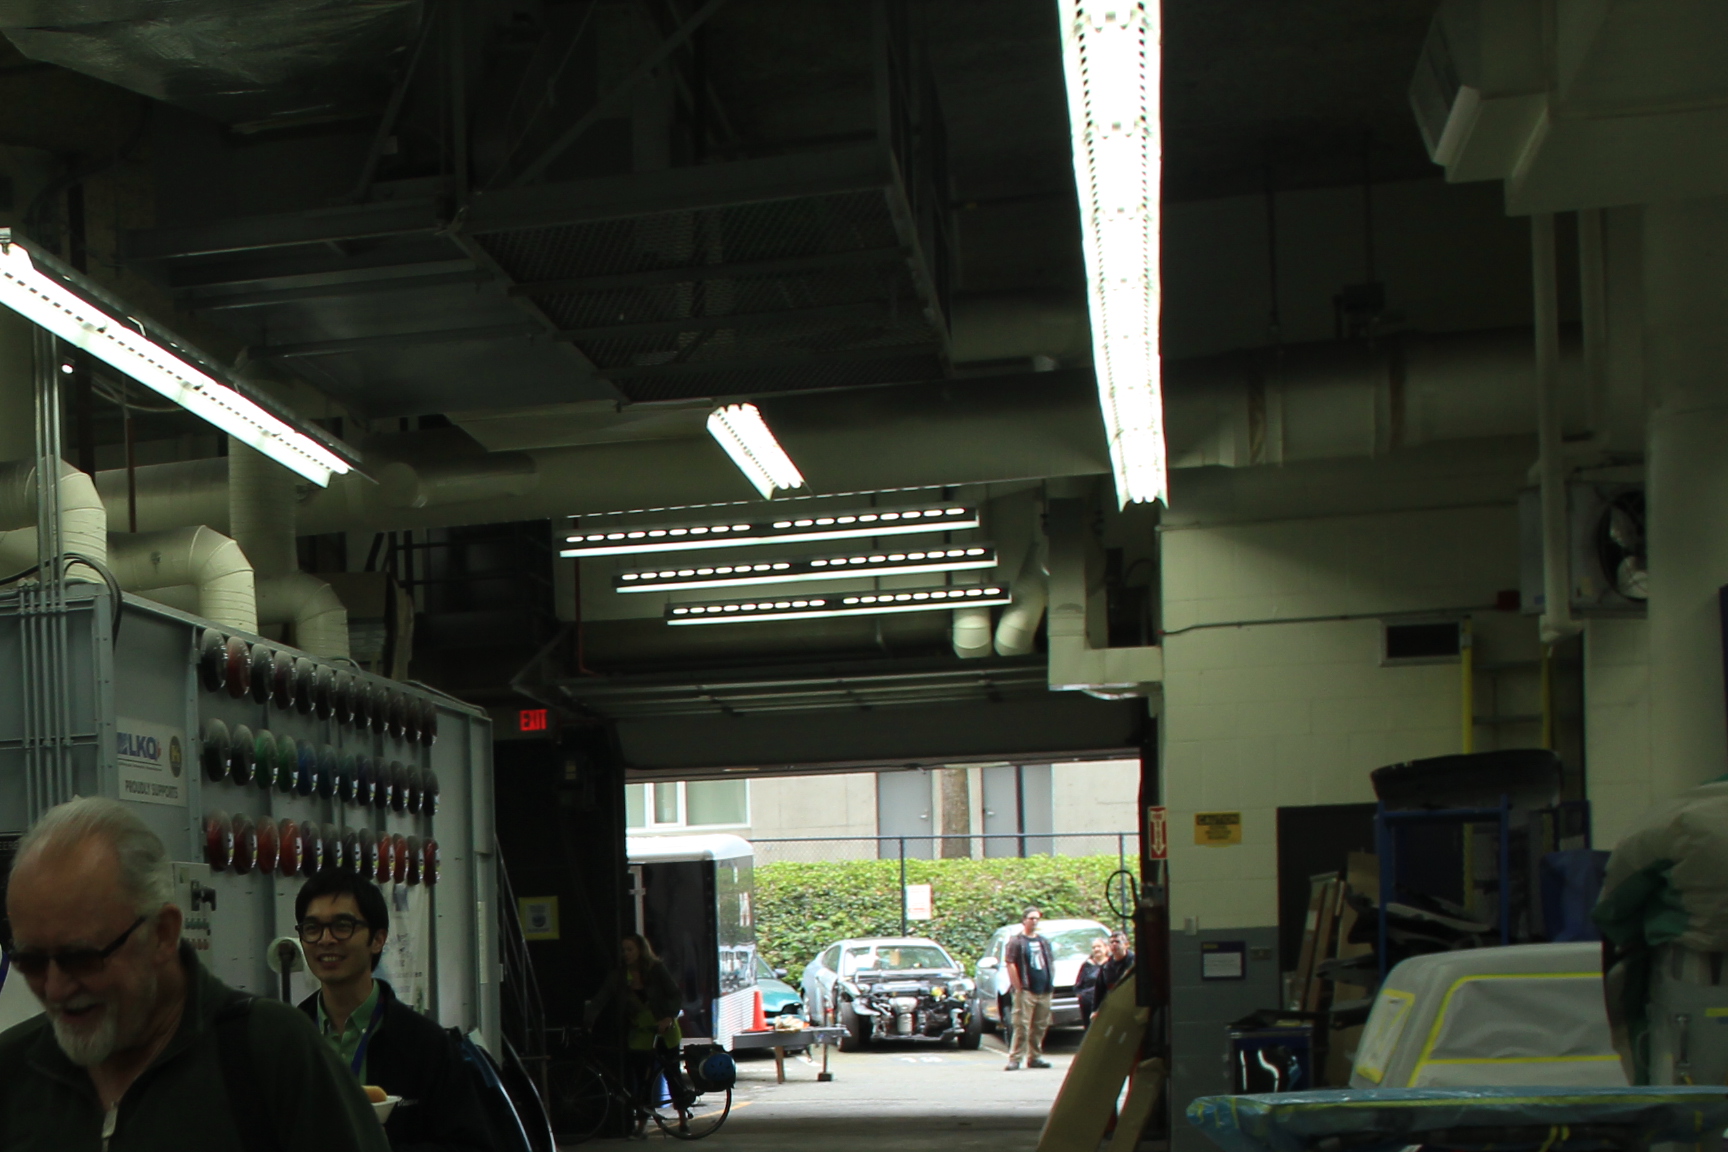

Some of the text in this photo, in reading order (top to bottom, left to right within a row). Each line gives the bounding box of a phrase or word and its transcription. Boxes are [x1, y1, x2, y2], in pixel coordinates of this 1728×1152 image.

[519, 709, 548, 731] EXIT
[129, 733, 158, 761] LKQ
[125, 780, 178, 799] PROUDLY SUPPORTS
